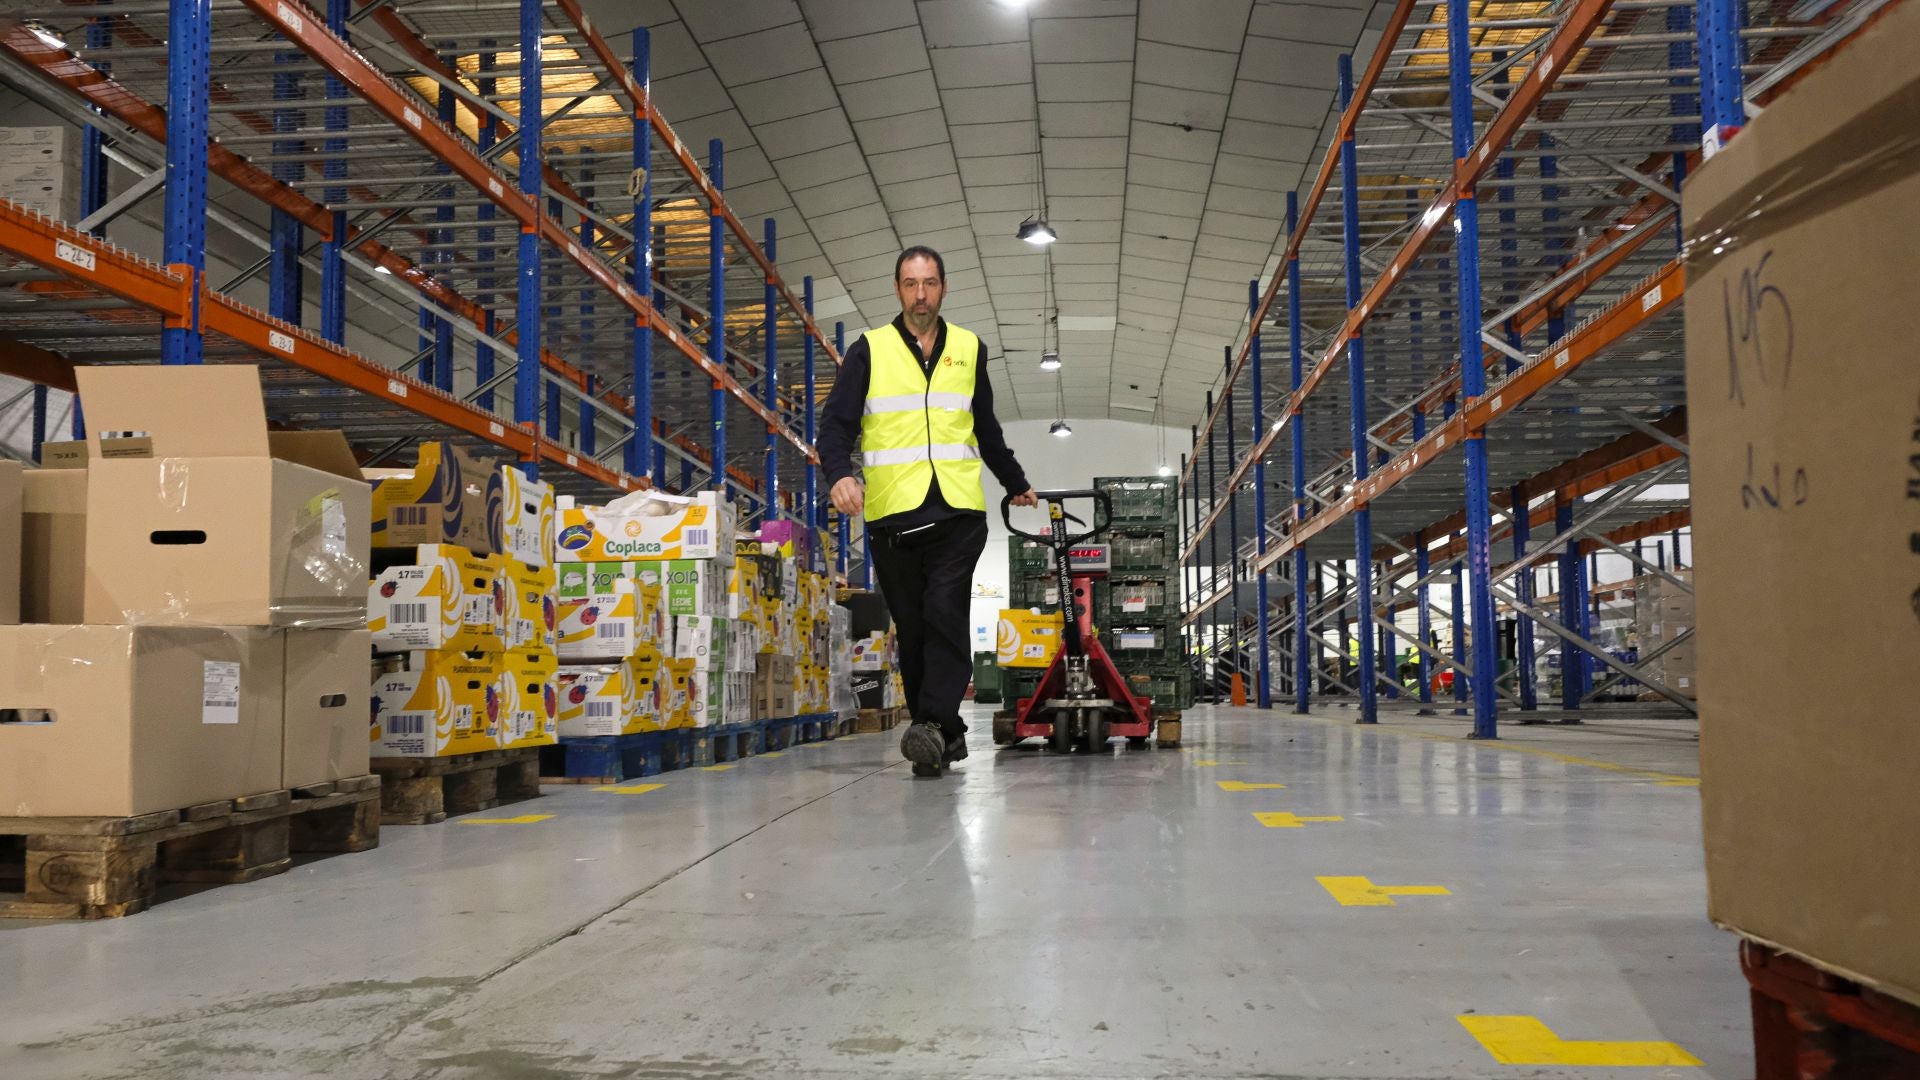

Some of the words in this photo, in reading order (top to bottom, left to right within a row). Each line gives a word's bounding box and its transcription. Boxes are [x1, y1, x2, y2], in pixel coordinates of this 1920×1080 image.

[605, 540, 662, 556] Coplaca
[398, 570, 410, 579] 17
[666, 571, 699, 585] XOIA
[385, 682, 397, 692] 17
